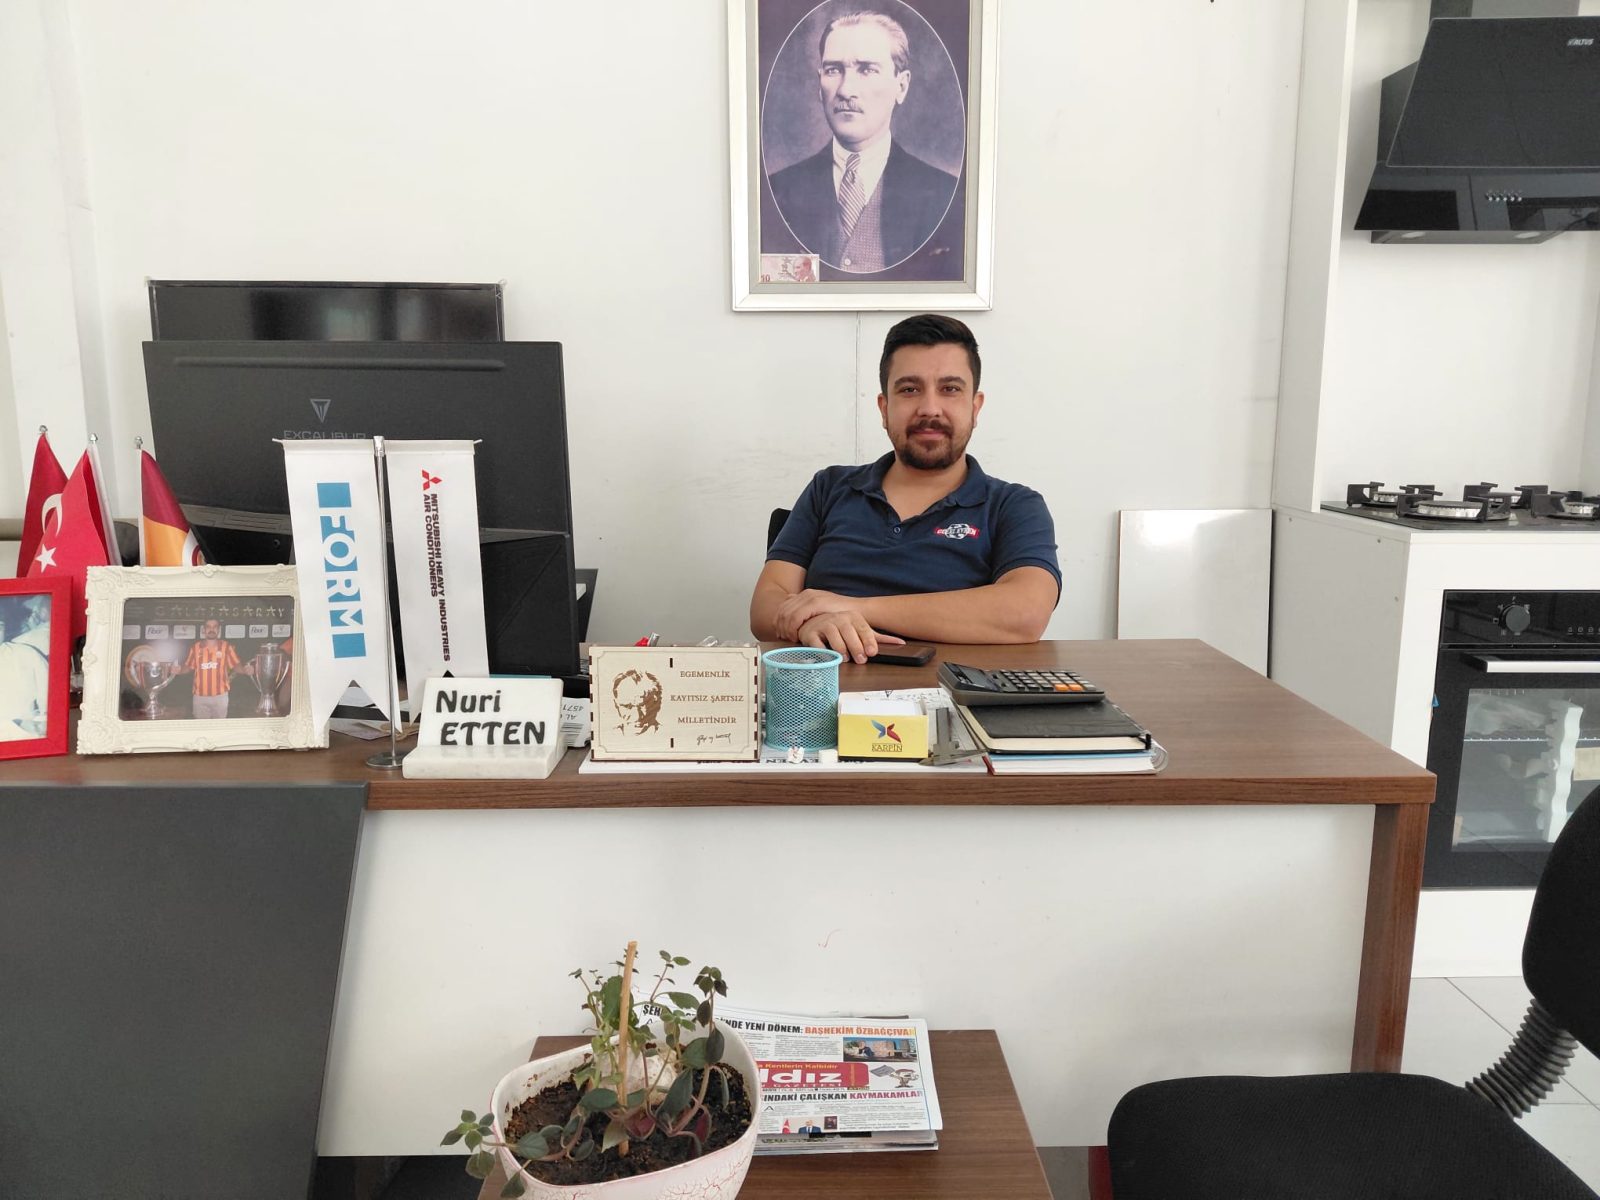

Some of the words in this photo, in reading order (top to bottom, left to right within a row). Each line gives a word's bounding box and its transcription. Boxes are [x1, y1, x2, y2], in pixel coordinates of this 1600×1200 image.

[423, 494, 431, 513] AIR
[430, 493, 442, 559] MITSUBISHI
[425, 515, 438, 597] CONDITIONERS
[319, 508, 365, 634] FORM
[435, 561, 445, 596] HEAVY
[439, 599, 450, 662] INDUSTRIES
[680, 669, 731, 678] EGEMENLİK
[435, 690, 501, 713] Nuri
[440, 721, 545, 745] ETTEN
[745, 1020, 766, 1032] YENİ
[760, 1064, 842, 1083] ldız
[800, 1092, 847, 1102] ÇALIŞKAN
